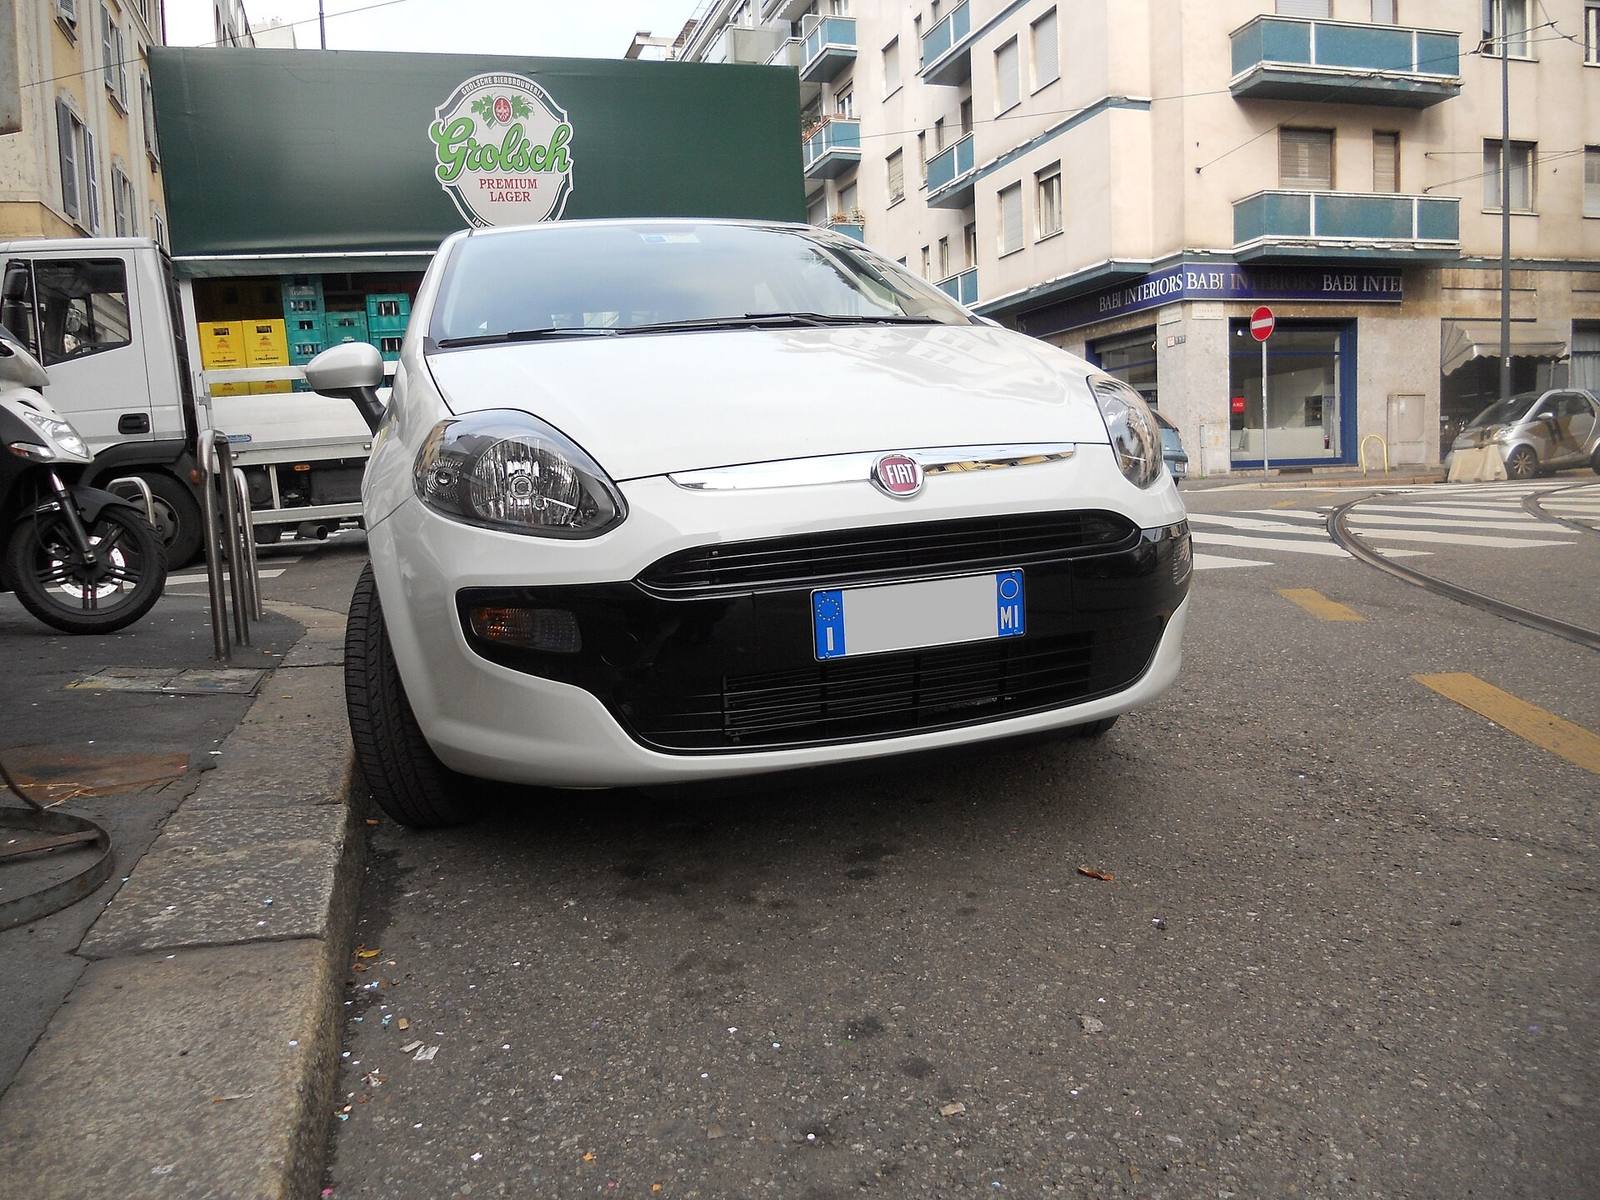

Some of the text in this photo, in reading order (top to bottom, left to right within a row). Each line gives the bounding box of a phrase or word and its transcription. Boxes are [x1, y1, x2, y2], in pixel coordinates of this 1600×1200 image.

[461, 76, 544, 99] GROLSCHE BIERBROUWERIJ
[430, 116, 571, 182] Grolsch
[479, 178, 538, 190] PREMIUM
[490, 191, 531, 202] LAGER
[1099, 273, 1183, 312] BABI INTERIORS
[1186, 272, 1225, 290] BABI
[1322, 274, 1358, 292] BABI
[886, 463, 914, 486] FIAT
[1000, 604, 1019, 630] MI
[826, 626, 834, 651] I
